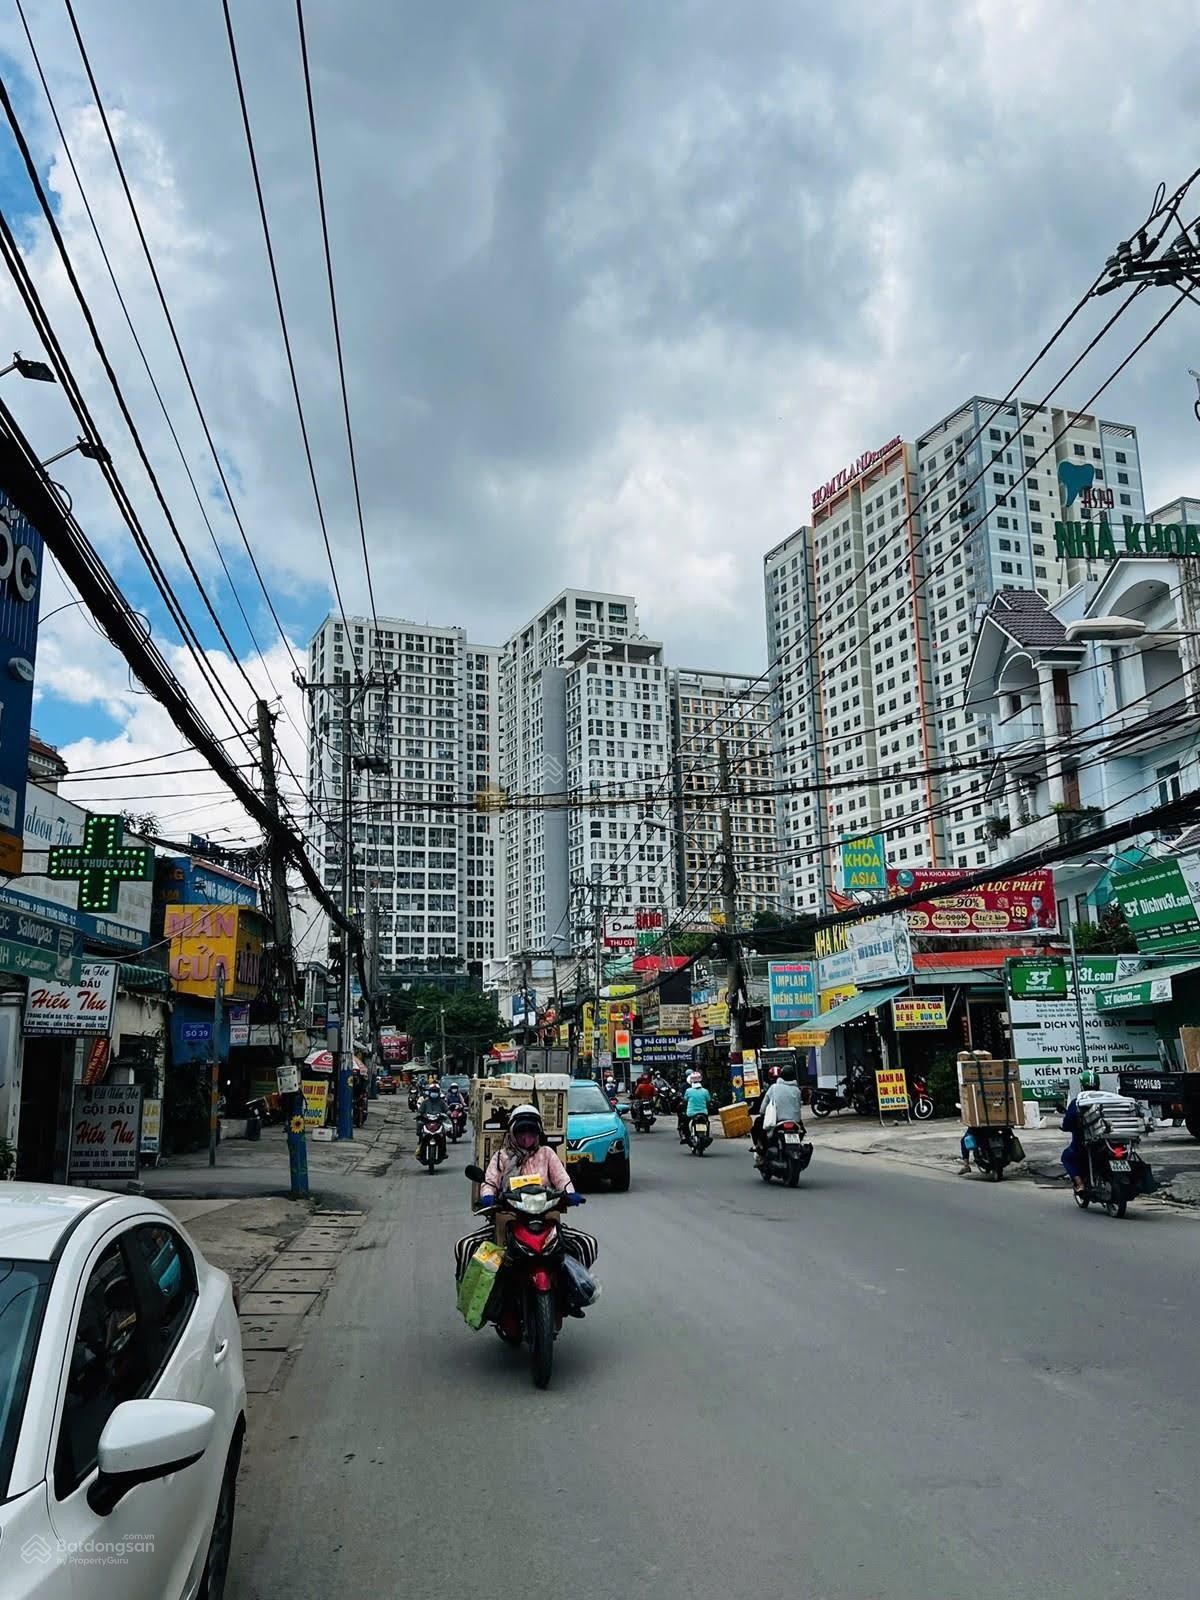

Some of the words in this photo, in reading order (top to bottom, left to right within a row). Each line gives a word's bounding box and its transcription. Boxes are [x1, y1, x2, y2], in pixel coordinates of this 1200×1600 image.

[1124, 520, 1200, 557] KHOA
[844, 853, 881, 868] KHOA
[850, 871, 878, 885] ASIA
[1011, 878, 1046, 892] PHÁT
[1010, 905, 1028, 918] 199
[17, 915, 53, 945] Salonpas
[775, 975, 808, 987] IMPLANT
[77, 991, 107, 1011] Thu
[1044, 1021, 1067, 1031] DỊCH
[1034, 1063, 1062, 1077] KIỂM
[1063, 1066, 1084, 1075] TRA
[82, 1103, 104, 1117] GỘI
[111, 1120, 135, 1145] Thu
